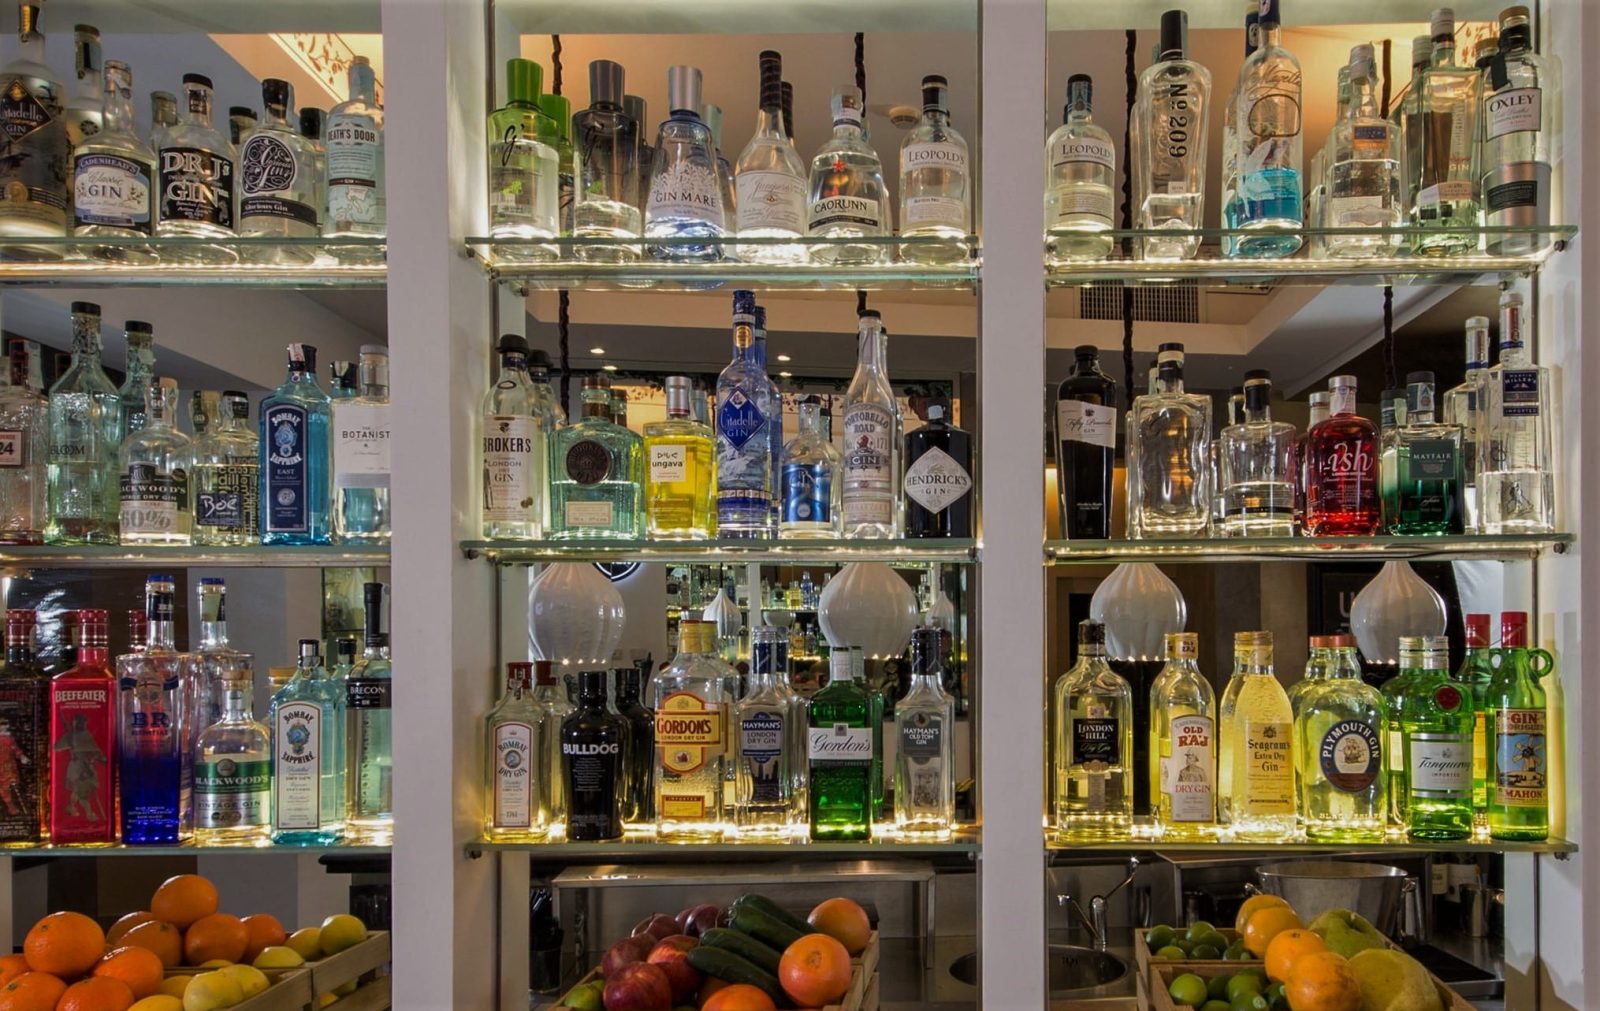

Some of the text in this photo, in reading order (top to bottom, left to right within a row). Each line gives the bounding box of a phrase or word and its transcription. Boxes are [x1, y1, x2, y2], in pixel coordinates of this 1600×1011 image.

[1489, 94, 1535, 112] OXLEY
[328, 128, 376, 142] DEATH'S DOOR
[1168, 115, 1188, 158] 209
[163, 152, 204, 174] DR
[88, 184, 122, 198] GIN
[167, 180, 229, 208] GIN
[655, 191, 717, 207] GIN MARE
[814, 199, 868, 213] CAORUNN
[720, 407, 760, 429] Citadelle
[844, 411, 889, 429] PORTOBELLO
[342, 430, 391, 438] BOTANIST
[727, 428, 750, 437] GIN
[853, 423, 875, 433] ROAD
[651, 460, 683, 468] ungava
[852, 456, 877, 464] GIN
[494, 473, 515, 482] GIN
[906, 474, 968, 487] HENDRICK'S
[55, 690, 107, 703] BEEFEATER
[350, 686, 386, 694] BRECON
[283, 710, 314, 723] BOMBAY
[1511, 713, 1539, 724] GIN
[657, 718, 712, 735] GORDON'S
[743, 721, 781, 729] HAYMAN'S
[1078, 723, 1115, 733] LONDON
[1183, 726, 1204, 734] OLD
[498, 740, 528, 752] BOMBAY
[811, 733, 871, 752] Gordon's
[1322, 722, 1380, 758] PLYMOUTH GIN
[281, 751, 315, 764] SAPPHIRE
[1254, 752, 1273, 760] Extra
[1261, 761, 1279, 772] Gin
[1418, 756, 1472, 771] Tanqueray
[1175, 784, 1211, 793] DRY GIN
[243, 801, 261, 809] GIN
